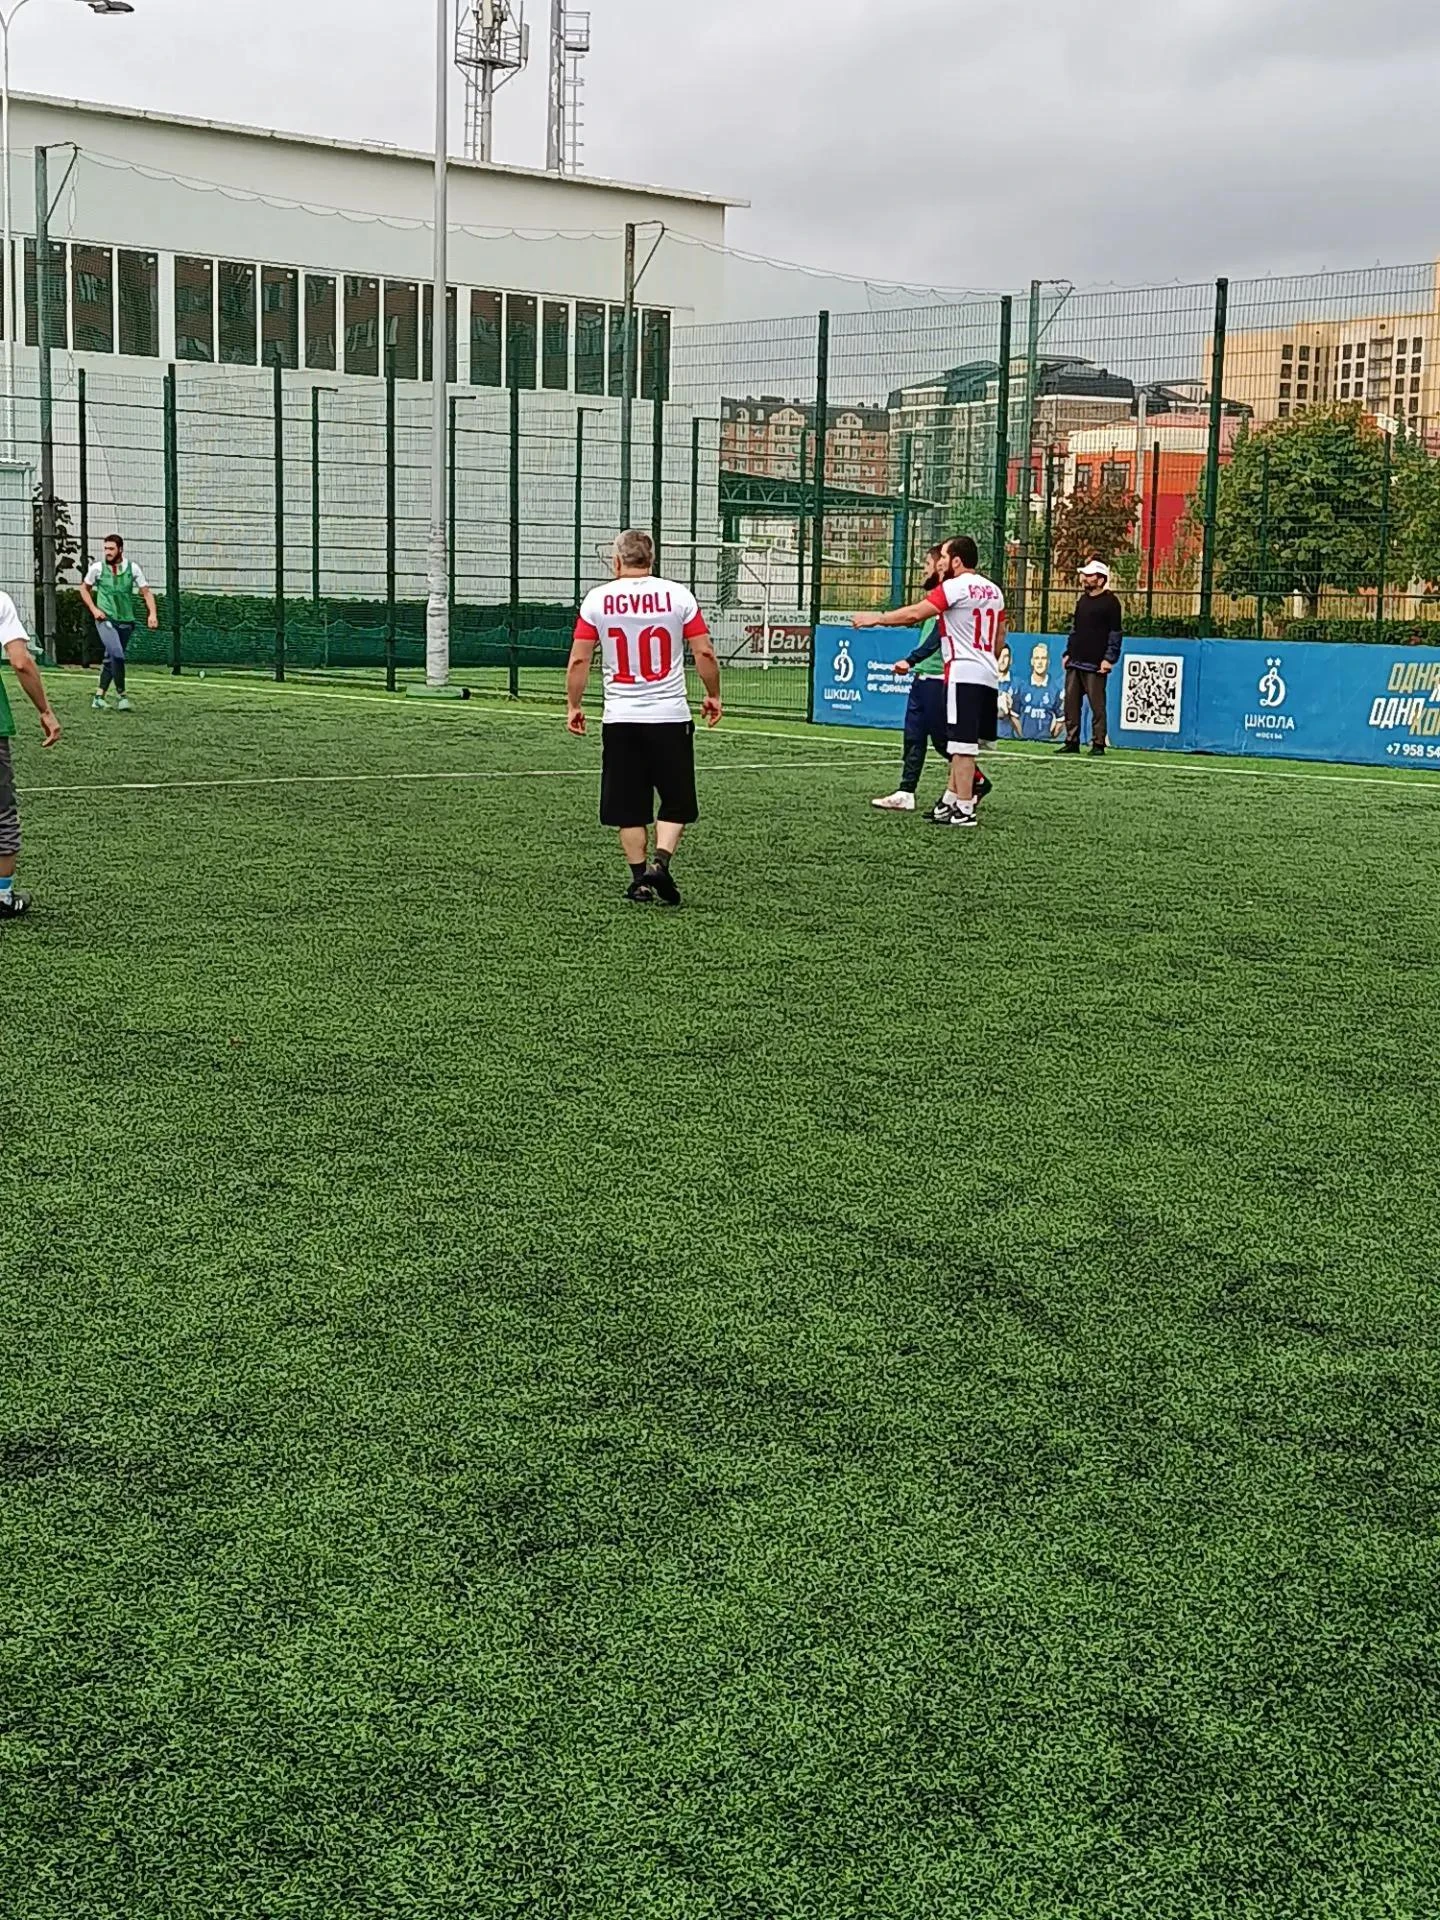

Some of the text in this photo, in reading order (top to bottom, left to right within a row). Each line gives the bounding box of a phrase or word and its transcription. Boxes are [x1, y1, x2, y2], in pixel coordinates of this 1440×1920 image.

[603, 592, 671, 615] AGVALI
[972, 608, 995, 652] 11
[608, 625, 671, 684] 10
[824, 688, 861, 701] ШКОЛА
[1245, 714, 1294, 731] ШКОЛА
[1402, 743, 1424, 757] 958
